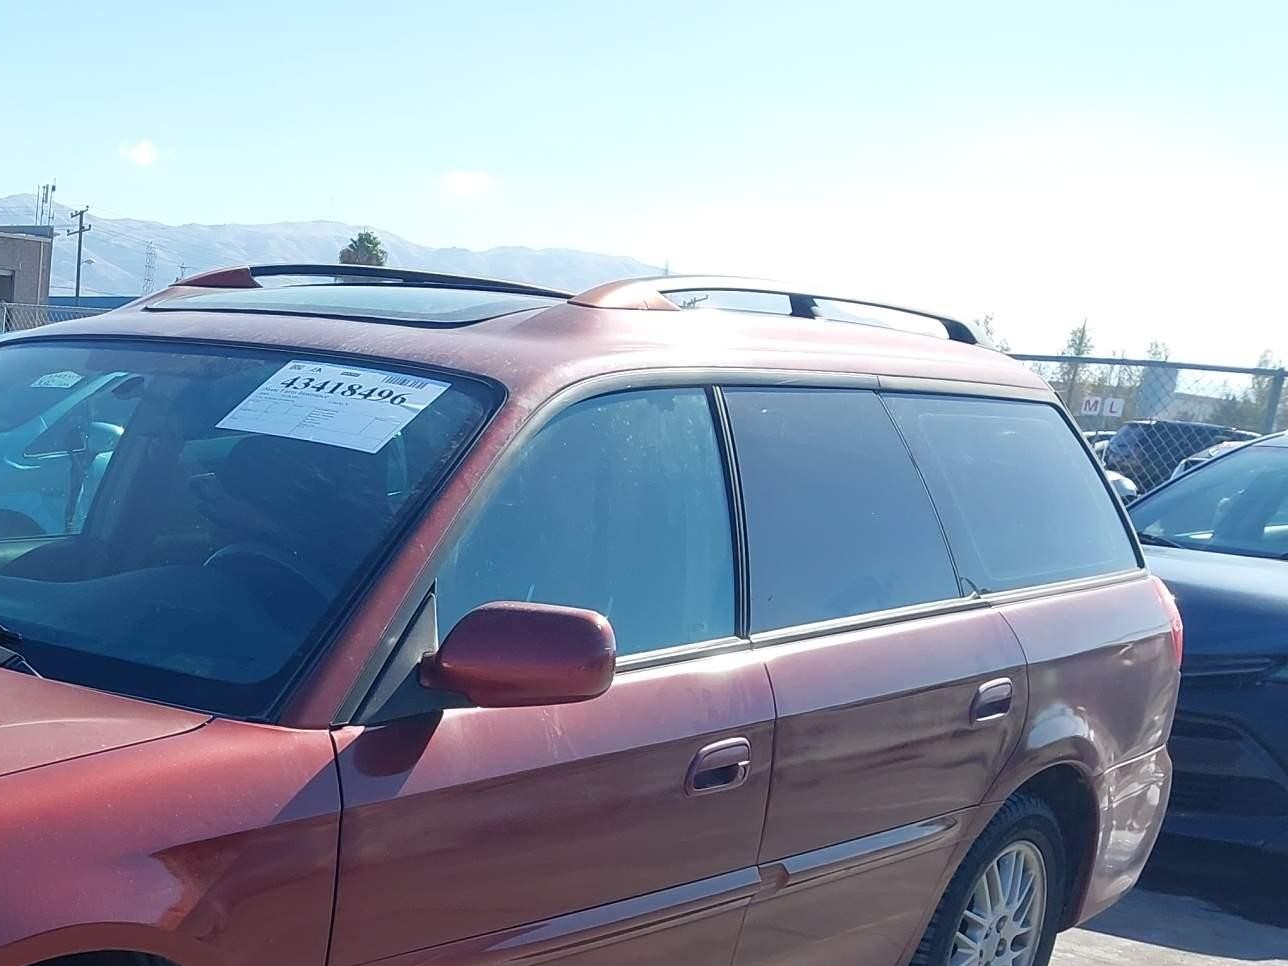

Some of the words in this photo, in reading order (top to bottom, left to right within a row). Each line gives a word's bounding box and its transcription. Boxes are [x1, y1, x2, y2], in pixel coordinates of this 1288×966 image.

[280, 375, 411, 405] 43418496
[1083, 399, 1099, 412] M
[1109, 400, 1118, 413] L
